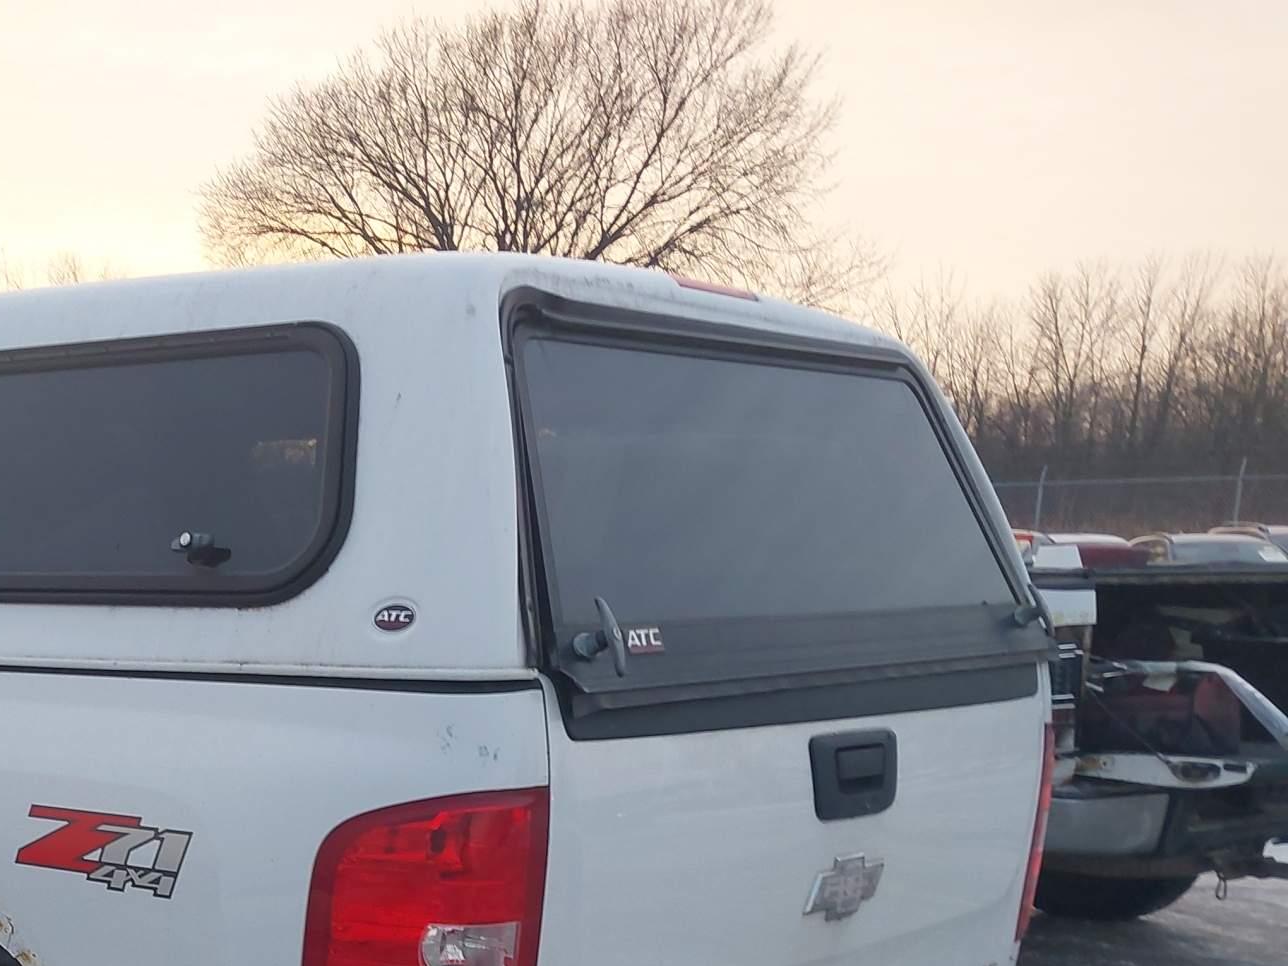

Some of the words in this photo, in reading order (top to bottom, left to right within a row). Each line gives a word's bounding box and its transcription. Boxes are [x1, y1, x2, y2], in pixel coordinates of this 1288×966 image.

[375, 609, 413, 622] ATC
[627, 627, 662, 649] ATC
[15, 804, 193, 876] Z71
